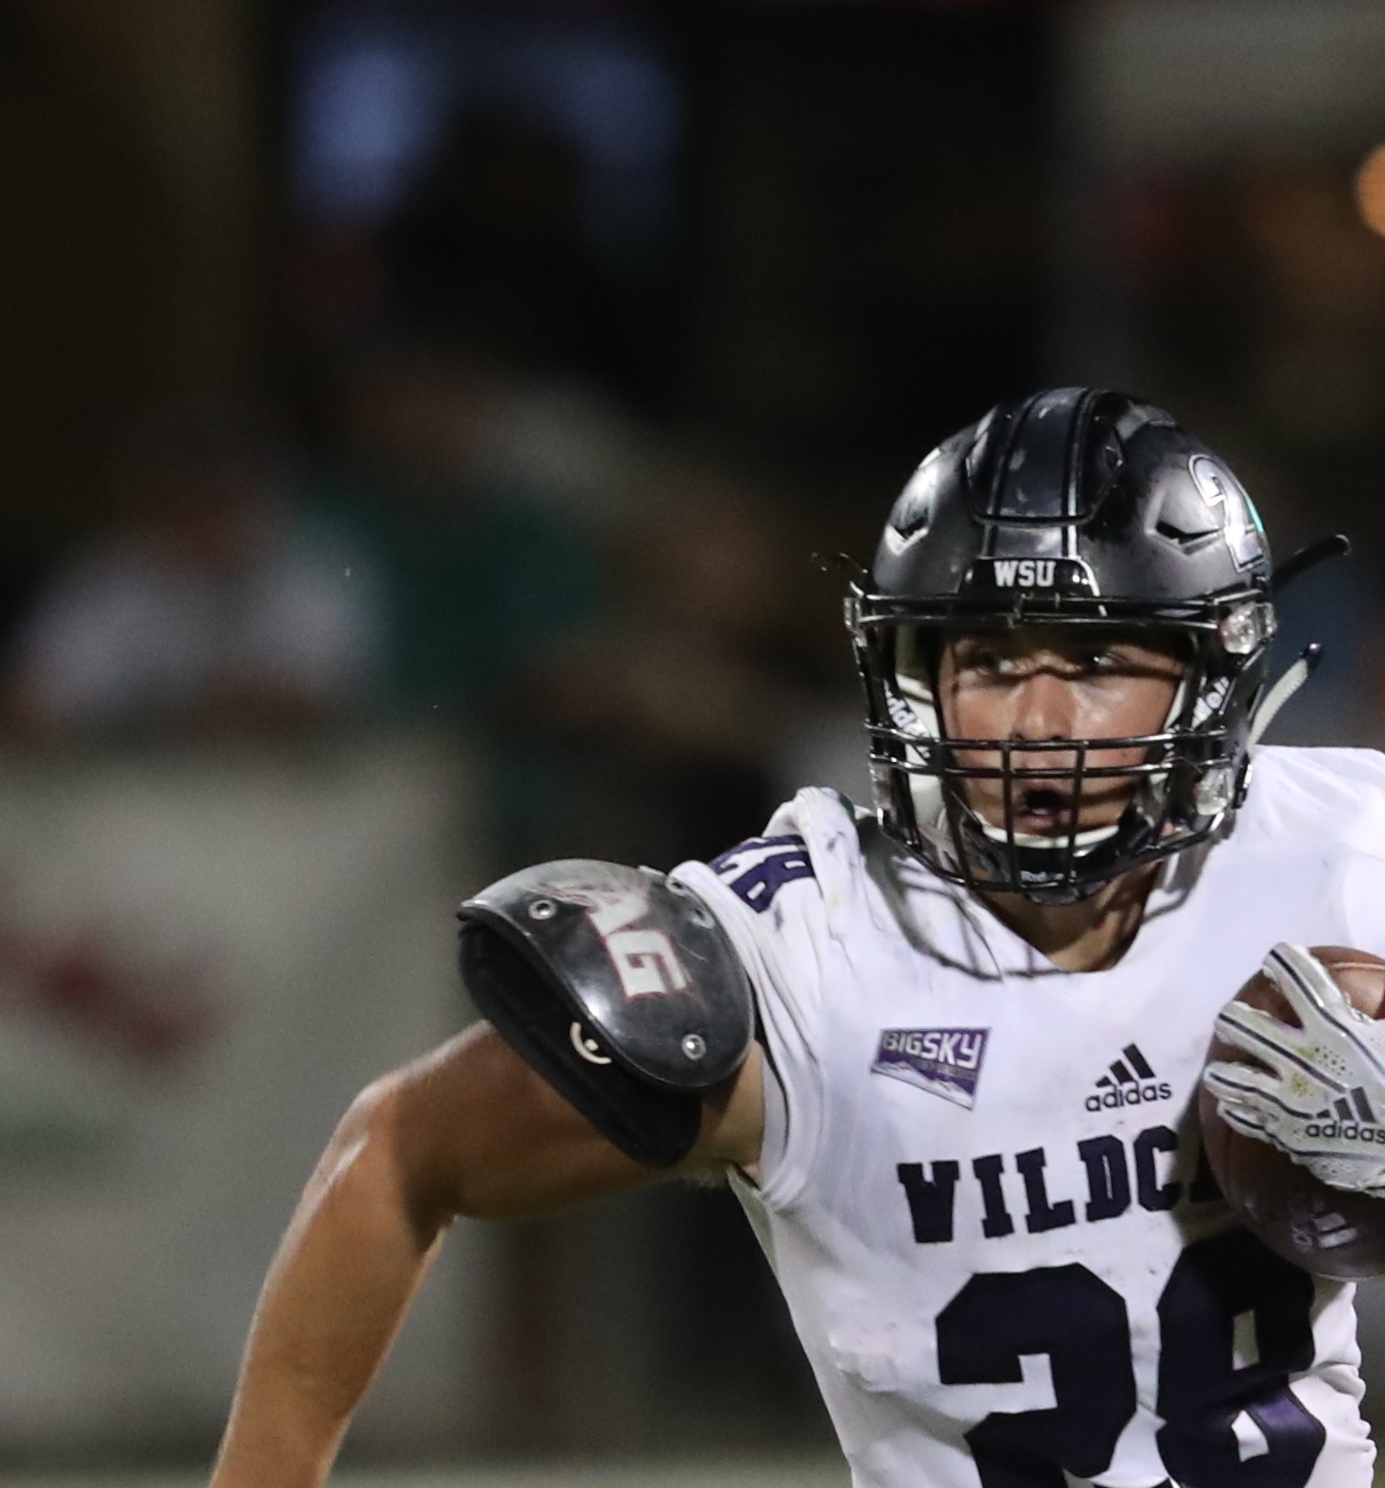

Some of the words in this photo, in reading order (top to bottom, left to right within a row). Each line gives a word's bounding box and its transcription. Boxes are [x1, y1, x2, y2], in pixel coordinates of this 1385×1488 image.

[994, 561, 1056, 587] WSU
[1085, 1080, 1172, 1112] adidas
[897, 1125, 1225, 1243] WILDC
